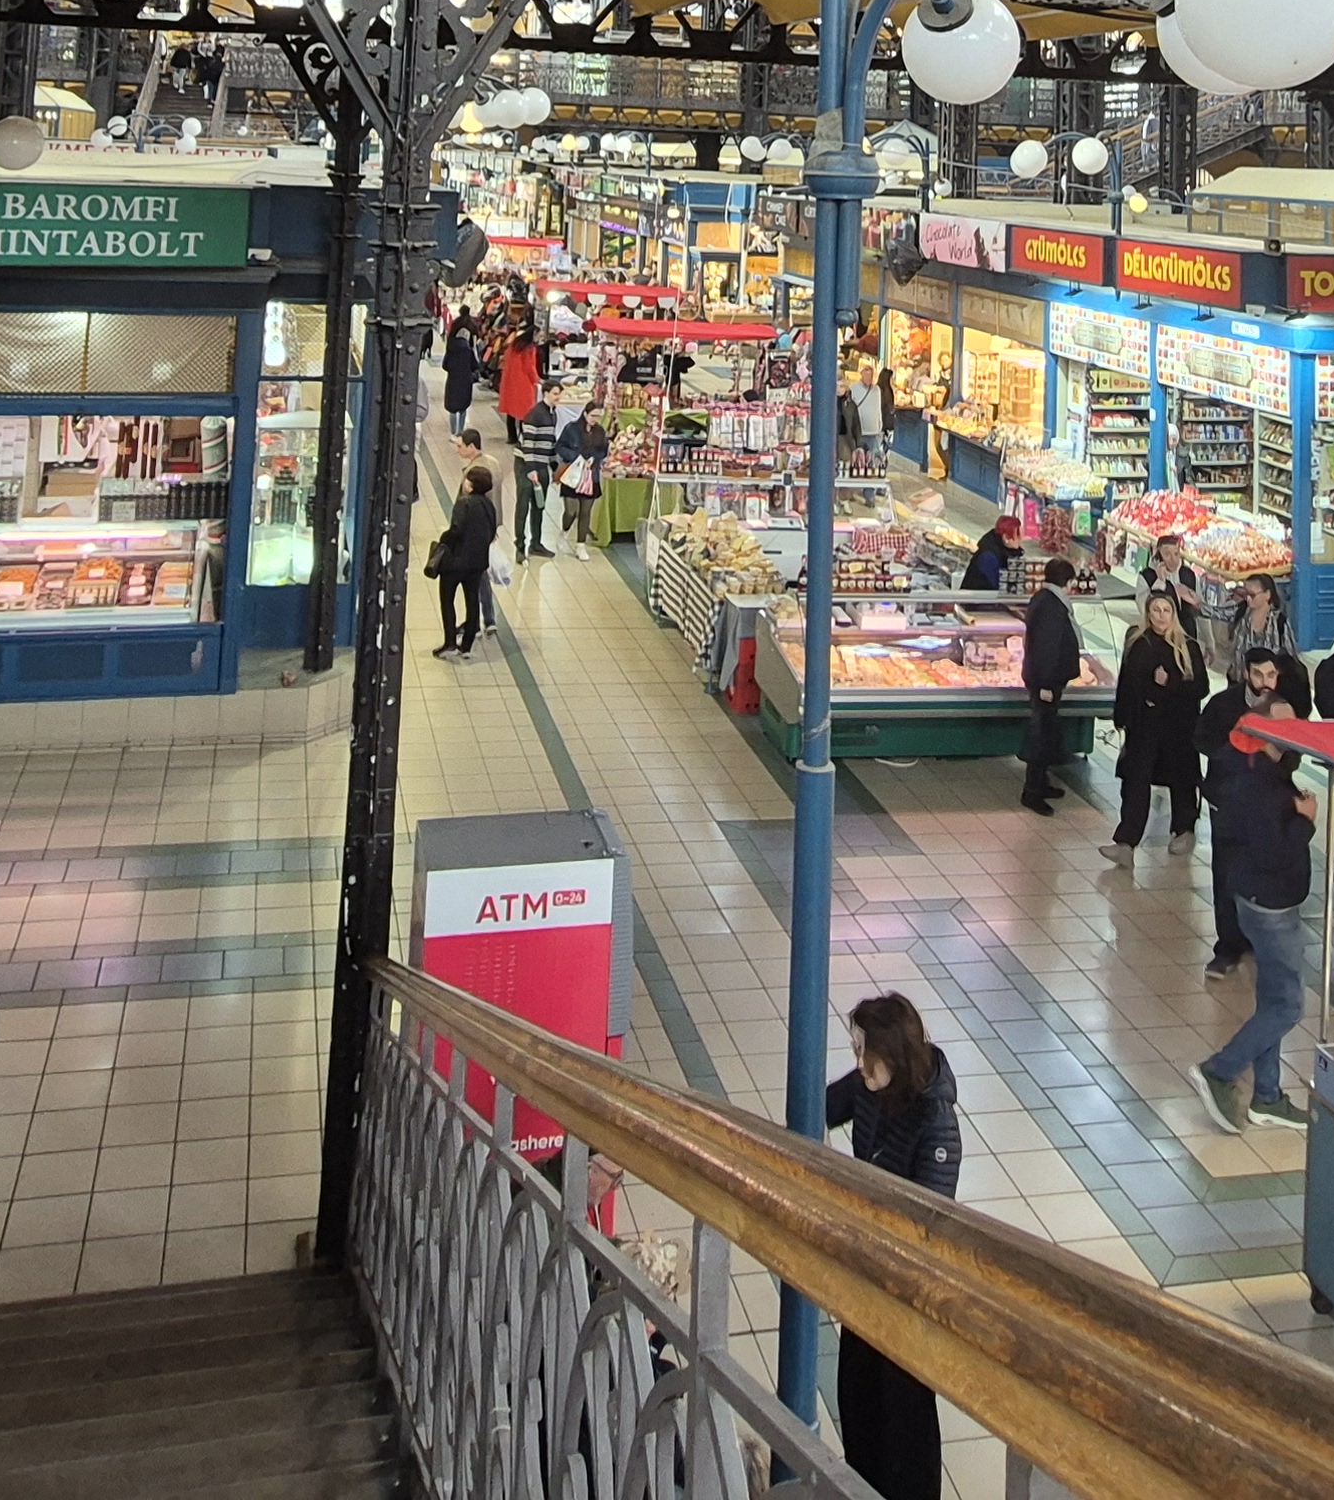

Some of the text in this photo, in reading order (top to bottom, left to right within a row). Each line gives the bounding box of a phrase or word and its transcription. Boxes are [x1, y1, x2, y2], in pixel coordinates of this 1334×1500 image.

[1, 192, 180, 223] BAROMFI
[925, 220, 961, 243] Chocolate
[948, 240, 974, 261] World
[475, 891, 584, 924] ATM 0-24
